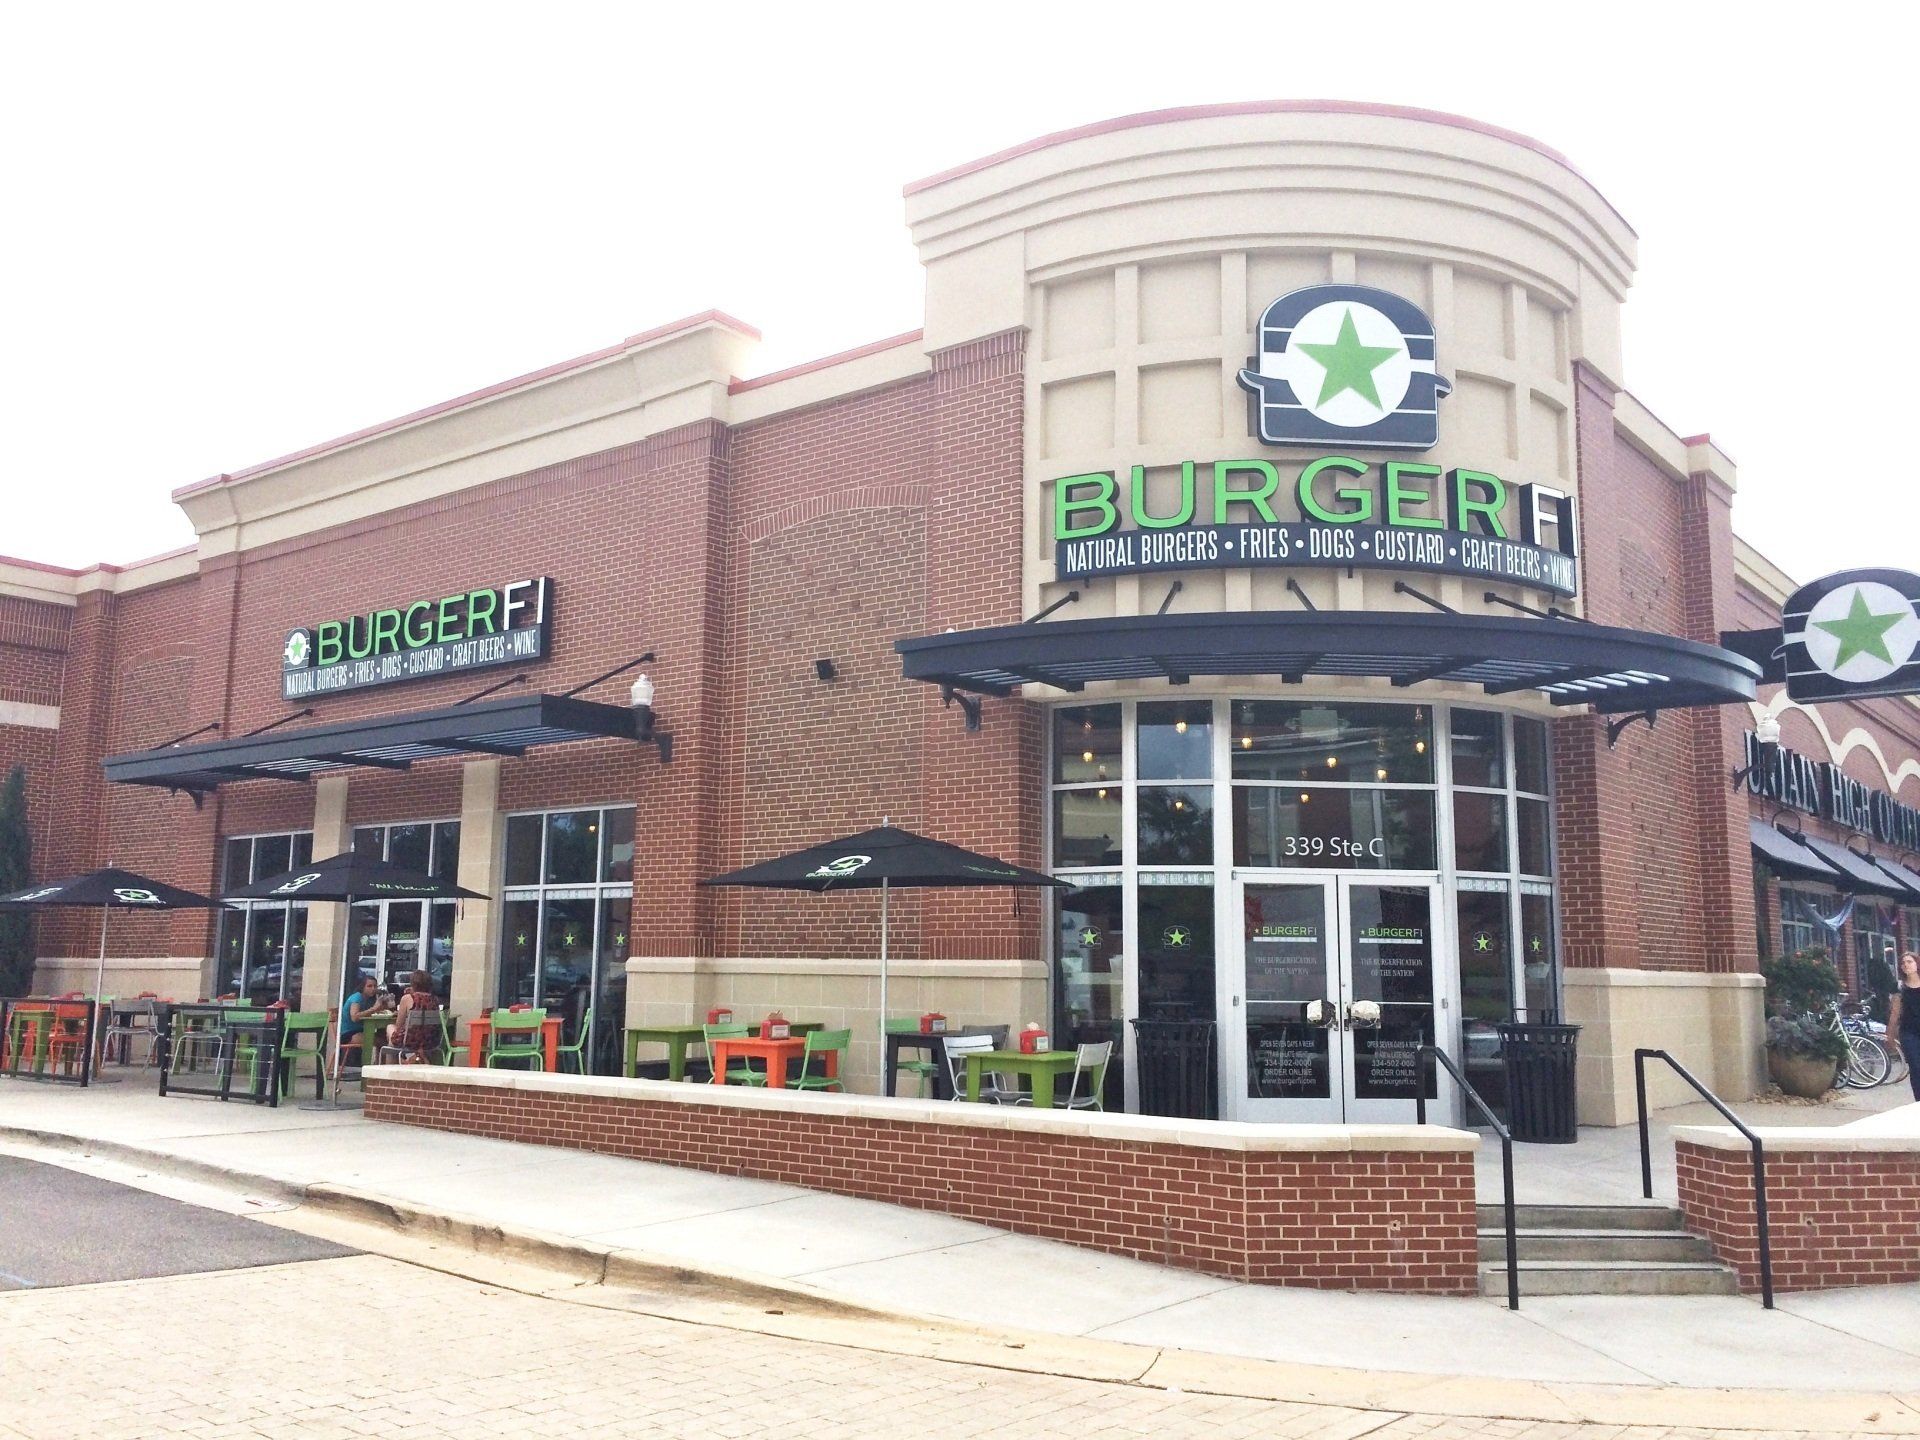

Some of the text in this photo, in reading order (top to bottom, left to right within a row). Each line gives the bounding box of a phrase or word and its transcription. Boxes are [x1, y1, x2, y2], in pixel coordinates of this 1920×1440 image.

[1066, 528, 1574, 590] NATURAL BURGERS FRIES DOGS CUSTARD CRAFT BEERS WINE
[318, 576, 546, 666] BURGERFI
[286, 629, 537, 696] NATURAL BURGERS FRIES DOGS CUSTARD CRAFT BEERS WINE
[1829, 762, 1874, 835] HIGH
[1284, 836, 1384, 857] 339 Ste C
[1262, 926, 1317, 936] BURGERFI
[1368, 927, 1423, 937] BURGERFI
